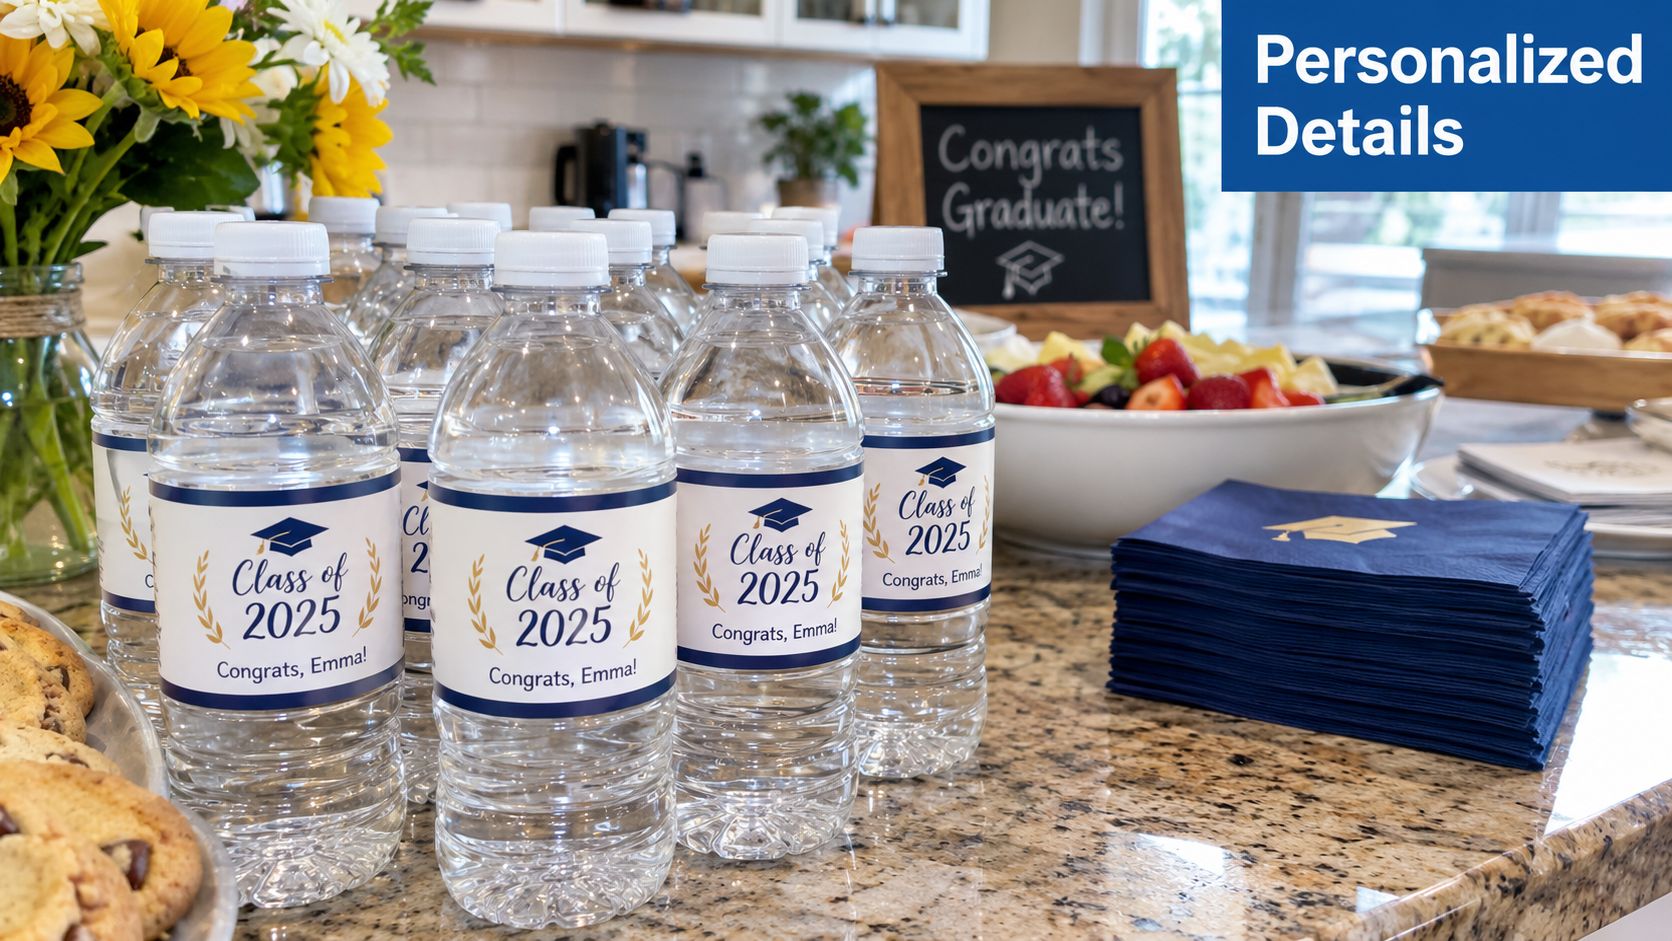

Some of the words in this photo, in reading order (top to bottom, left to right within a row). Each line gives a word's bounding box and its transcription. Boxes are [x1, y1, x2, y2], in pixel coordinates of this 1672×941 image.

[938, 123, 1125, 189] Congrats
[942, 181, 1125, 239] Graduate!
[899, 490, 956, 521] Class
[960, 486, 976, 518] of
[730, 532, 798, 566] Class
[805, 531, 826, 566] of
[905, 519, 971, 556] 2025
[232, 558, 313, 596] Class
[321, 551, 349, 591] of
[506, 565, 586, 602] Class
[594, 562, 621, 603] of
[737, 568, 819, 606] 2025
[882, 572, 948, 591] Congrats,
[951, 563, 983, 584] Emma!
[242, 594, 341, 640] 2025
[515, 604, 612, 647] 2025
[712, 623, 788, 645] Congrats,
[793, 617, 837, 639] Emma!
[216, 661, 304, 684] Congrats,
[311, 645, 367, 674] Emma!
[489, 666, 575, 692] Congrats,
[581, 658, 637, 685] Emma!
